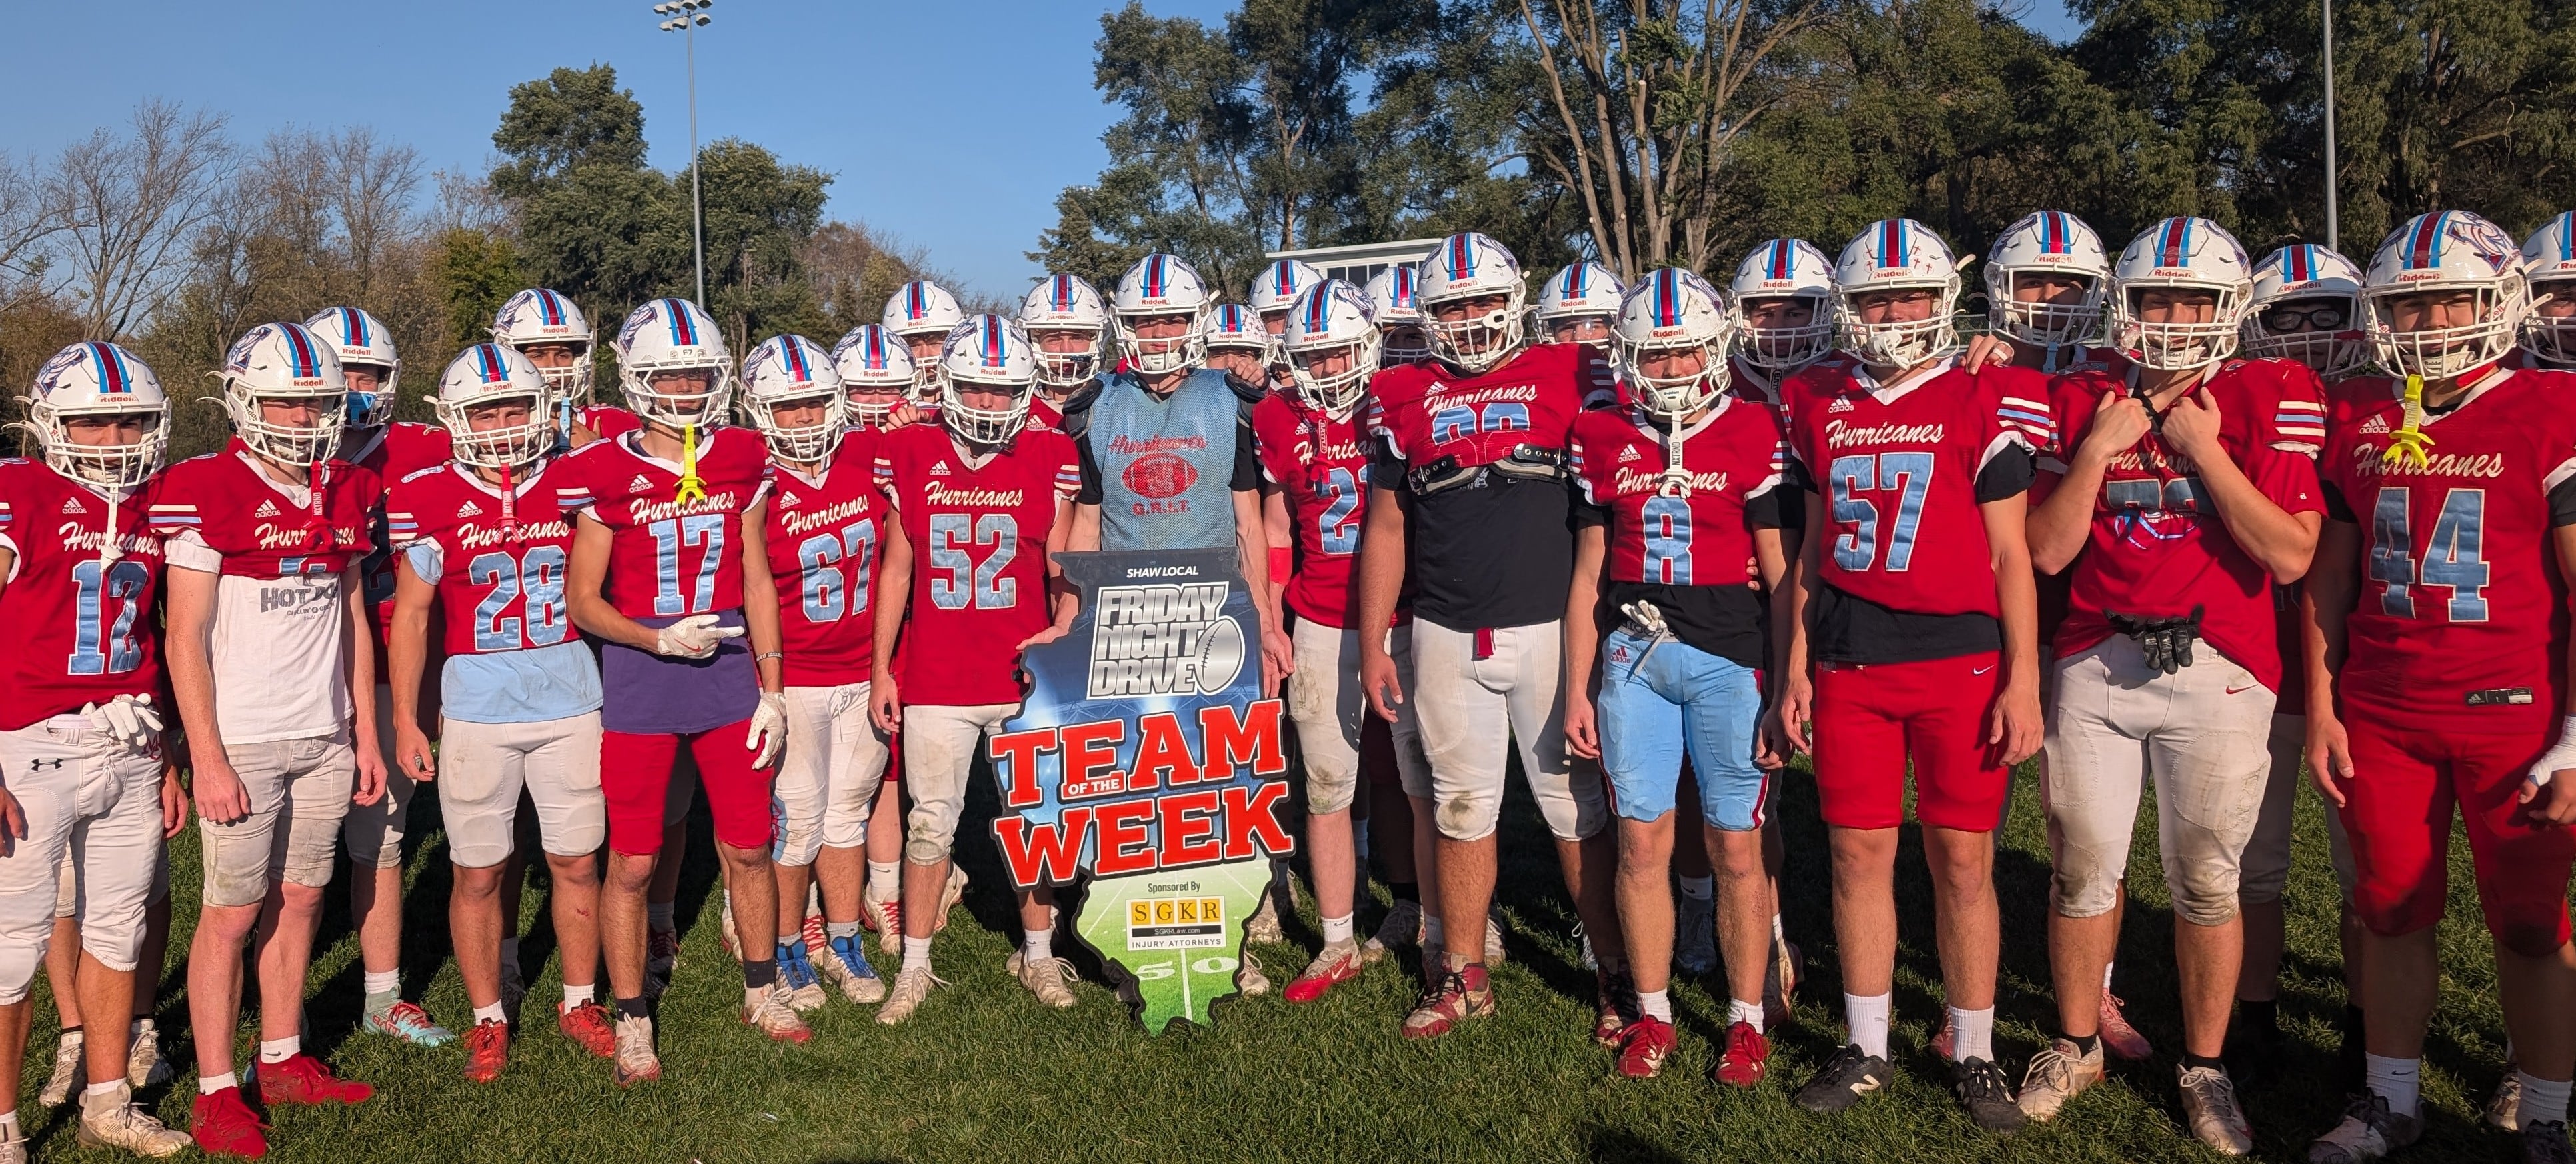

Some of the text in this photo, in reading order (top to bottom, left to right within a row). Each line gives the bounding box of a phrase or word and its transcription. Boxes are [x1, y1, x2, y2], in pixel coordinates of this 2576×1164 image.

[2155, 269, 2191, 277] Riddell
[1304, 333, 1328, 342] Riddell
[1653, 329, 1684, 337] Riddell
[483, 383, 513, 392] Riddell
[789, 383, 815, 391] Riddell
[1424, 384, 1537, 416] Hurricanes
[1828, 405, 1854, 413] adidas
[1826, 419, 1944, 450] Hurricanes
[2359, 426, 2390, 434] adidas
[1618, 453, 1642, 463] adidas
[1672, 441, 1681, 465] NXTRND
[629, 483, 654, 493] adidas
[924, 480, 1024, 507] Hurricanes
[255, 510, 281, 518] adidas
[313, 492, 323, 516] NXTRND
[457, 509, 483, 518] adidas
[780, 499, 801, 509] adidas
[782, 494, 869, 537] Hurricanes
[1830, 451, 1935, 572] 57
[648, 514, 725, 615] 17
[930, 514, 1017, 610] 52
[2369, 487, 2490, 623] 44
[800, 517, 875, 623] 67
[1127, 566, 1199, 578] SHAW LOCAL
[261, 587, 311, 613] HOT
[469, 546, 569, 651] 28
[1100, 586, 1224, 625] FRIDAY
[67, 559, 149, 675] 12
[1096, 621, 1205, 660] NIGHT
[1090, 657, 1196, 695] DRIVE
[990, 699, 1286, 807] TEAM
[1068, 779, 1120, 795] OF THE
[994, 782, 1294, 887] WEEK
[1148, 881, 1201, 894] Sponsored By
[1135, 901, 1219, 921] SGKR
[1132, 938, 1222, 949] INJURY ATTORNEYS
